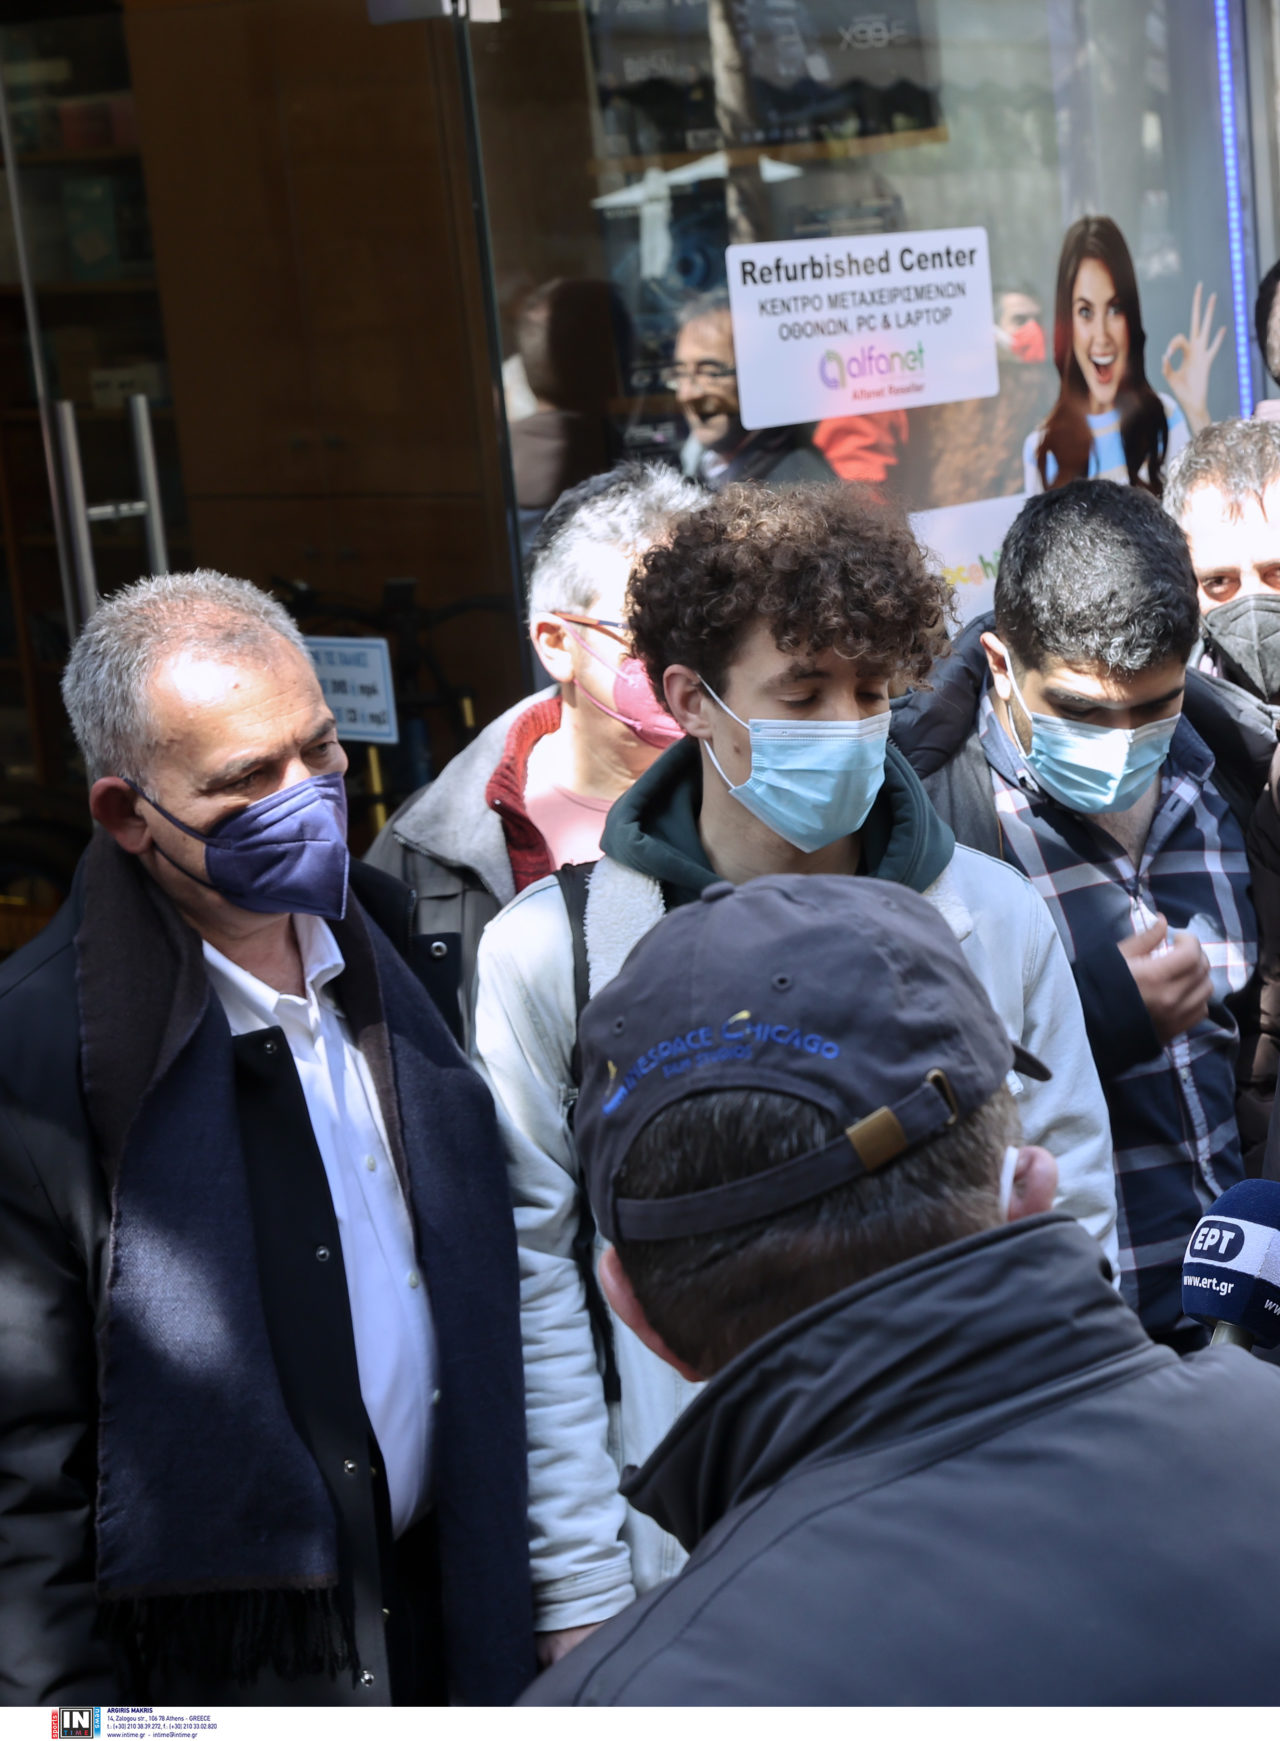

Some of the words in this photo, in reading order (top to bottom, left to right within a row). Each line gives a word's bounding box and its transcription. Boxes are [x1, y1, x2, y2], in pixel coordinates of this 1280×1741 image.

[740, 248, 891, 286] Refurbished
[900, 246, 978, 272] Center
[758, 293, 824, 317] ΚΕΝΤΡΟ
[857, 314, 877, 333] PC
[881, 313, 892, 330] &
[895, 306, 953, 329] LAPTOP
[846, 341, 926, 379] alfanet
